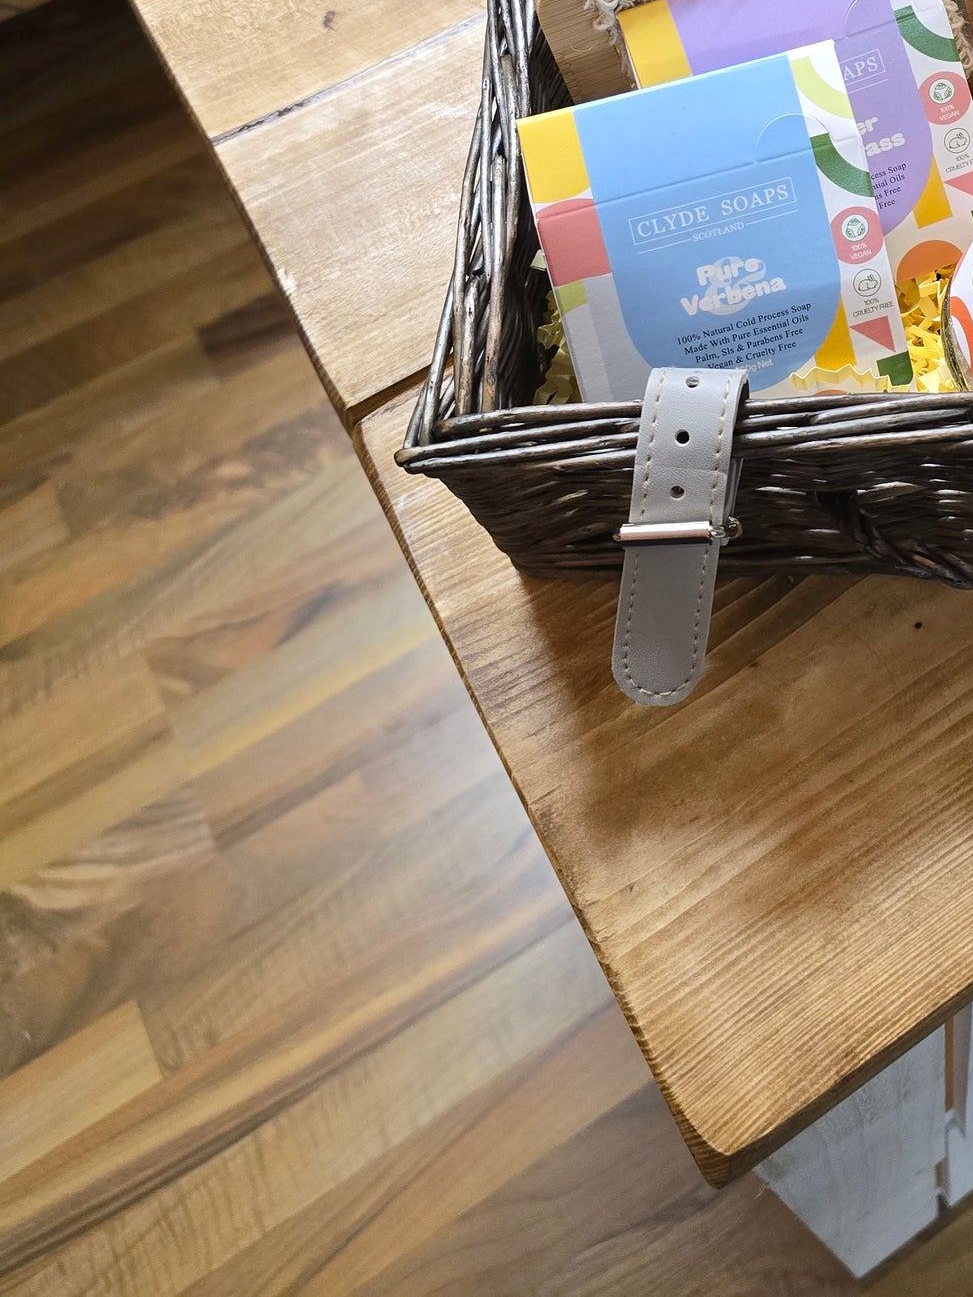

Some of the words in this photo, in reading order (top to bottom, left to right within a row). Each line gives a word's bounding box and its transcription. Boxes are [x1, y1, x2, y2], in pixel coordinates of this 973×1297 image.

[940, 104, 955, 113] 100%
[939, 110, 960, 121] VEGAN
[955, 153, 970, 161] 100%
[888, 162, 907, 175] Soap
[945, 161, 970, 174] CRUELTY
[889, 174, 906, 185] Oils
[884, 186, 901, 197] Free
[878, 199, 896, 210] Free
[637, 206, 710, 239] CLYDE
[721, 184, 789, 216] SOAPS
[692, 222, 745, 242] SCOTLAND
[851, 243, 867, 252] 100%
[850, 249, 872, 261] VEGAN
[696, 257, 760, 286] Pure
[680, 277, 787, 316] Verbena
[863, 297, 879, 306] 100%
[852, 304, 879, 318] CRUELTY
[879, 300, 894, 310] FREE
[677, 333, 701, 346] 100%
[703, 323, 734, 339] Natural
[736, 316, 756, 329] Cold
[758, 309, 789, 323] Process
[791, 302, 812, 315] Soap
[684, 343, 708, 355] Made
[710, 337, 731, 349] With
[732, 331, 751, 343] Pure
[753, 320, 789, 337] Essential
[792, 313, 809, 325] Oils
[695, 351, 719, 364] Palm,
[722, 346, 735, 356] Sls
[736, 344, 744, 352] &
[747, 334, 784, 350] Parabens
[785, 328, 804, 339] Free
[707, 359, 734, 370] Vegan
[736, 355, 743, 364] &
[745, 346, 776, 361] Cruelty
[778, 341, 797, 353] Free
[757, 359, 773, 369] Net
